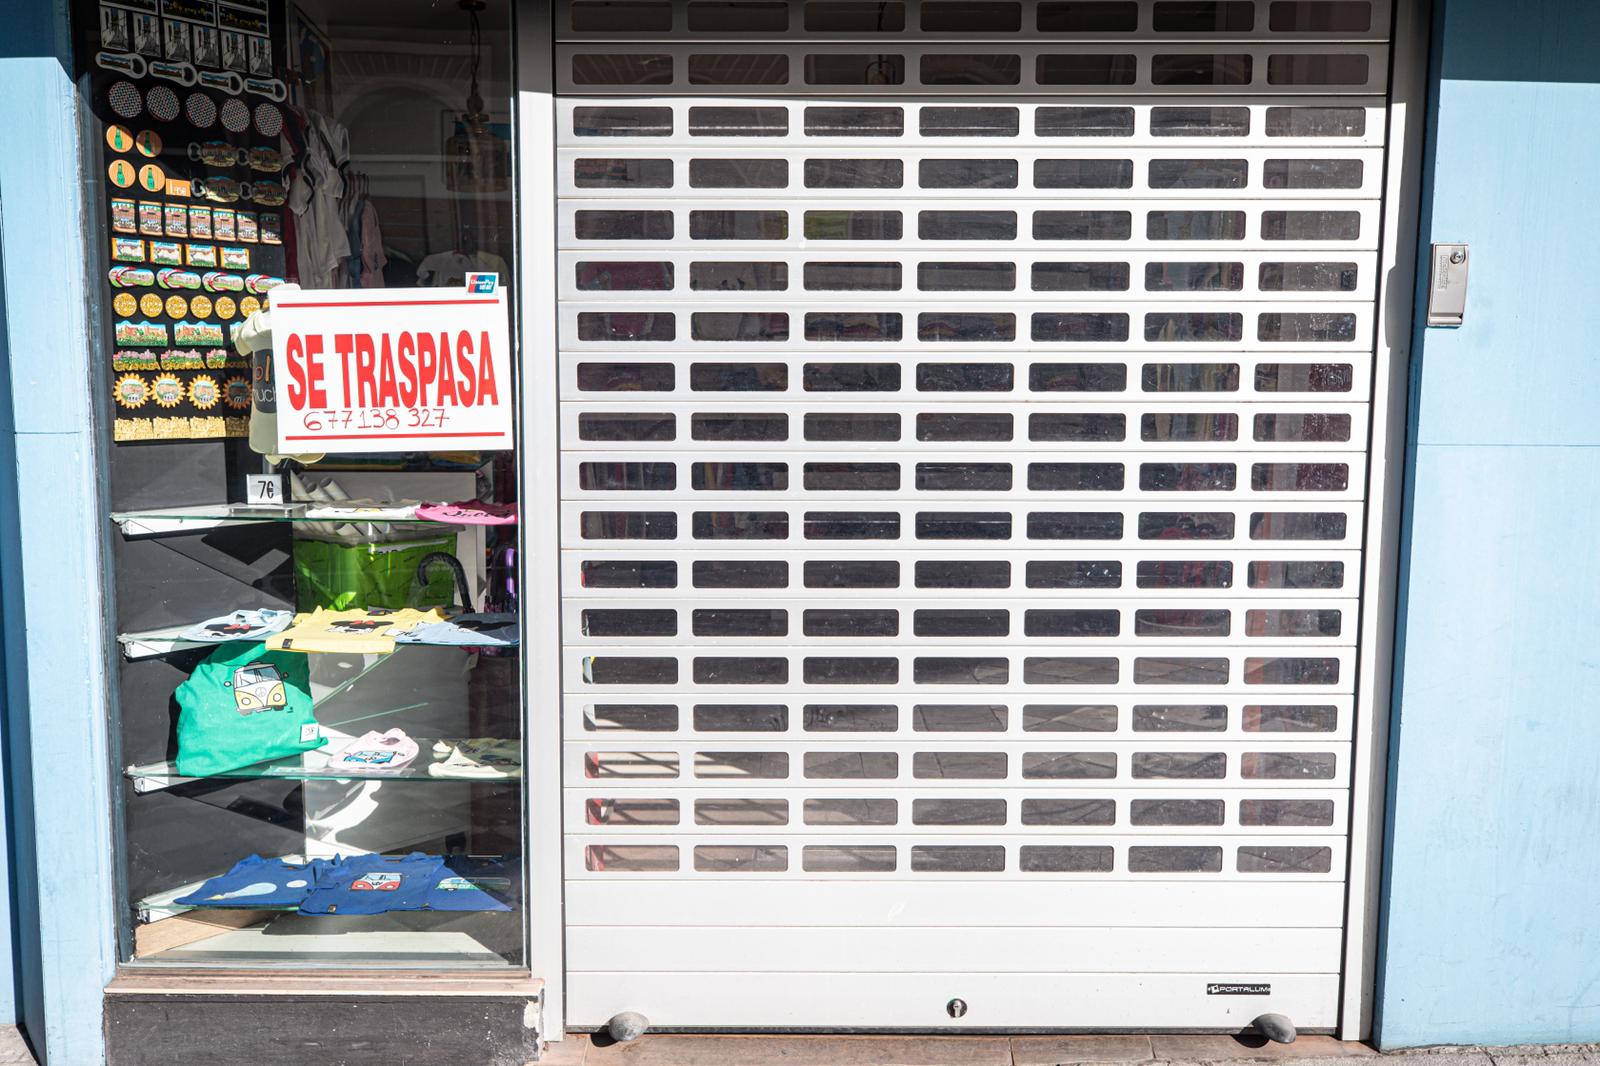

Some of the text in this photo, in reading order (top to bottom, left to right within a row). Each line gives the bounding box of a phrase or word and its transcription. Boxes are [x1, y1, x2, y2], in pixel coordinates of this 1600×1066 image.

[287, 329, 498, 411] SE TRASPASA
[407, 408, 450, 428] 327
[257, 480, 274, 499] 7€
